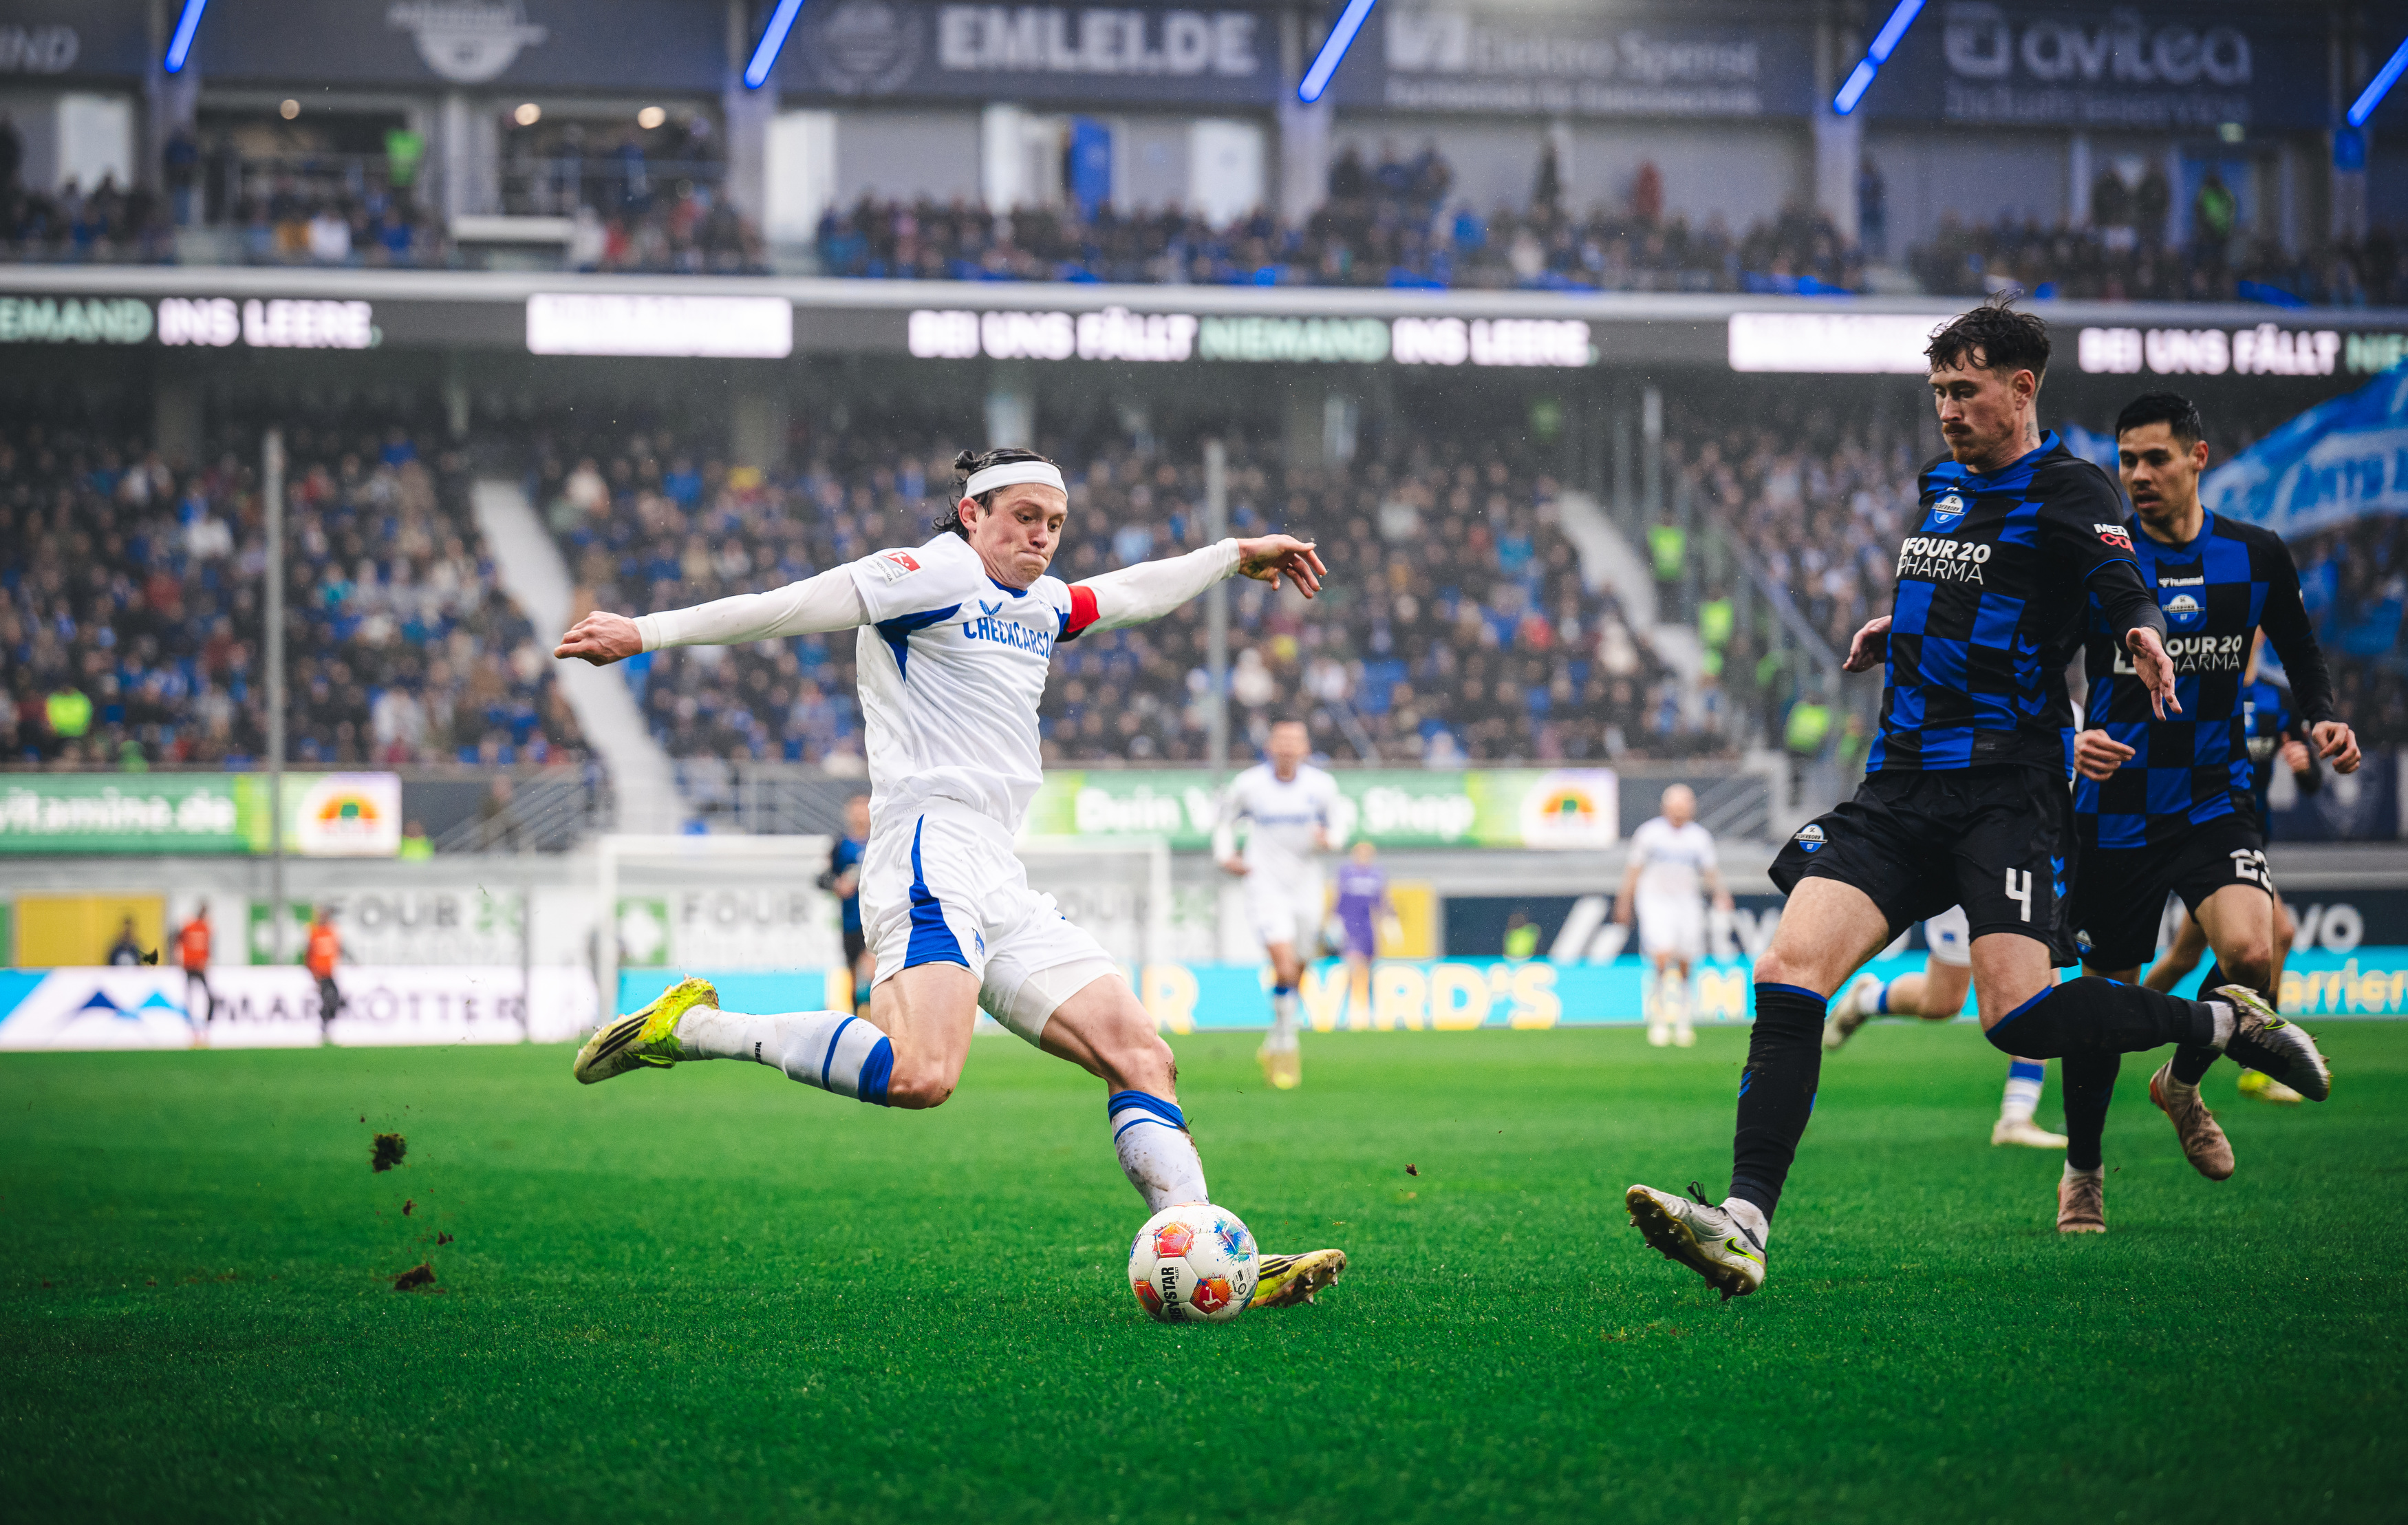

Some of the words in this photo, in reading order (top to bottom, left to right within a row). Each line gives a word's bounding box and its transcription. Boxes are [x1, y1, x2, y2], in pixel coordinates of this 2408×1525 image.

[938, 9, 1258, 77] EMLEI.DE
[1906, 537, 1959, 559] FOUR
[1957, 542, 1992, 564] 20
[1900, 556, 1984, 585] PHARMA
[2166, 636, 2217, 657] OUR
[2219, 634, 2242, 654] 20
[2006, 868, 2032, 921] 4
